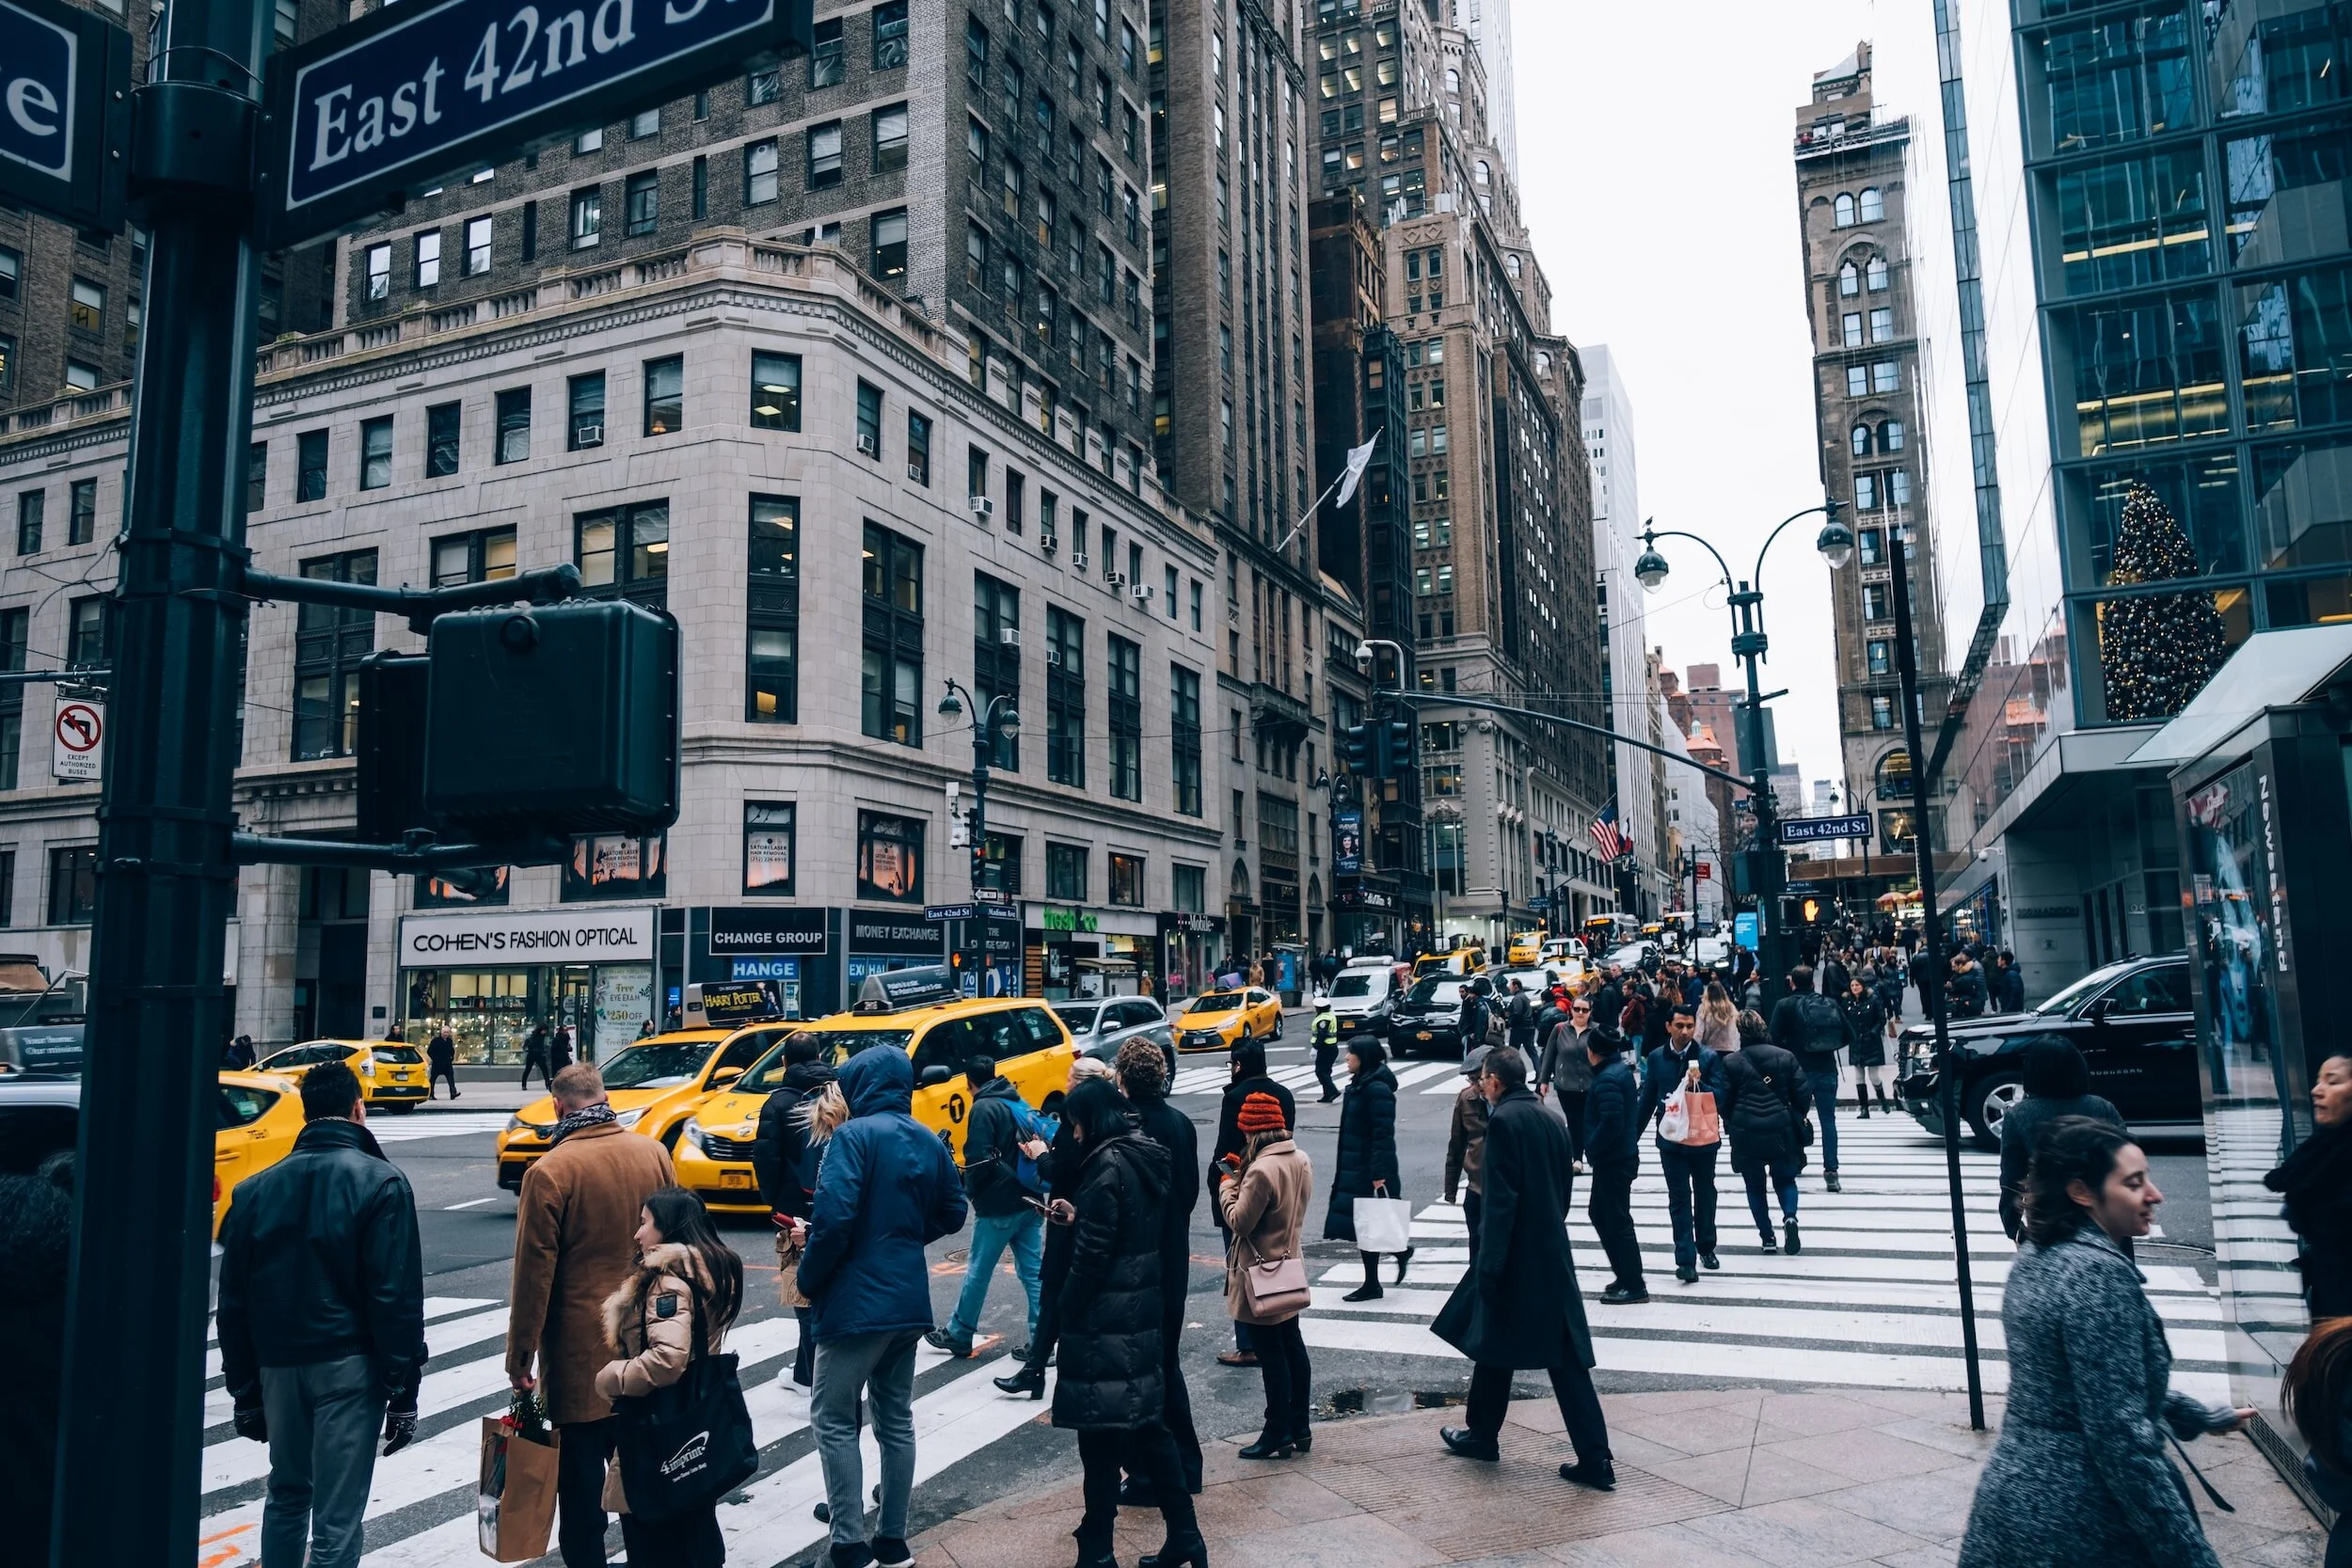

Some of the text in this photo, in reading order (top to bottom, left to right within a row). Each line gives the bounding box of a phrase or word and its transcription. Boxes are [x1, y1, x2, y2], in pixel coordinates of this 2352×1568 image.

[309, 0, 636, 172] East 42nd
[59, 761, 97, 769] AUTHORIZED
[1786, 820, 1867, 837] East 42nd St
[928, 908, 970, 919] East 42nd St
[988, 908, 1016, 918] Madison Ave
[1043, 906, 1098, 932] fresh&co
[715, 932, 823, 943] CHANGE GROUP
[856, 925, 939, 942] MONEY EXCHANGE
[987, 927, 1000, 937] THE
[413, 927, 638, 952] COHEN'S FASHION OPTICAL
[733, 963, 794, 976] HANGE
[615, 983, 635, 993] Free
[622, 993, 641, 1002] EXAM
[704, 991, 763, 1008] HARRY POTTER
